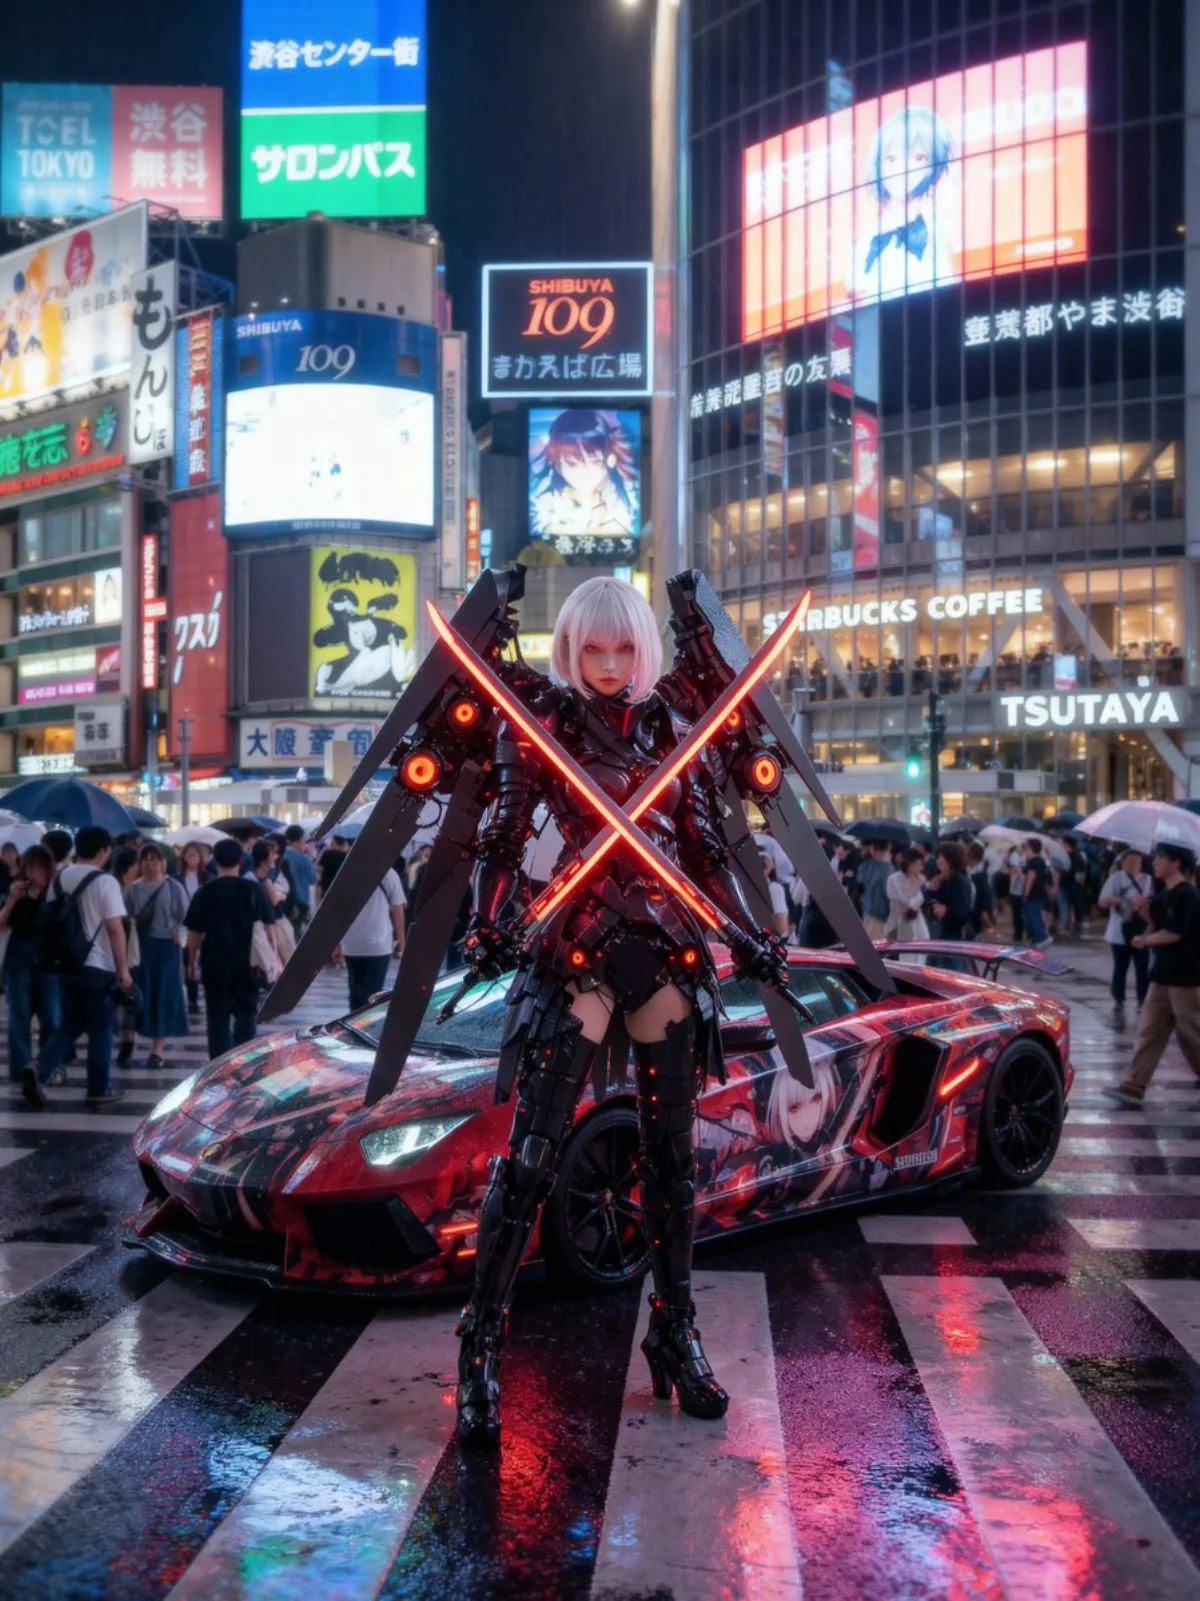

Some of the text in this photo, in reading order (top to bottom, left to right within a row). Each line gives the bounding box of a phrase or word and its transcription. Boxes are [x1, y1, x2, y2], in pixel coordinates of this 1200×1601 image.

[249, 37, 419, 69] 渋谷センター街
[130, 102, 207, 141] 渋谷
[131, 148, 208, 189] 無料
[252, 142, 415, 182] サロンパス
[529, 278, 614, 294] SHIBUYA
[236, 319, 302, 338] SHIBUYA
[522, 296, 615, 349] 109
[295, 344, 356, 380] 109
[927, 588, 1043, 620] COFFEE
[1001, 691, 1180, 727] TSUTAYA
